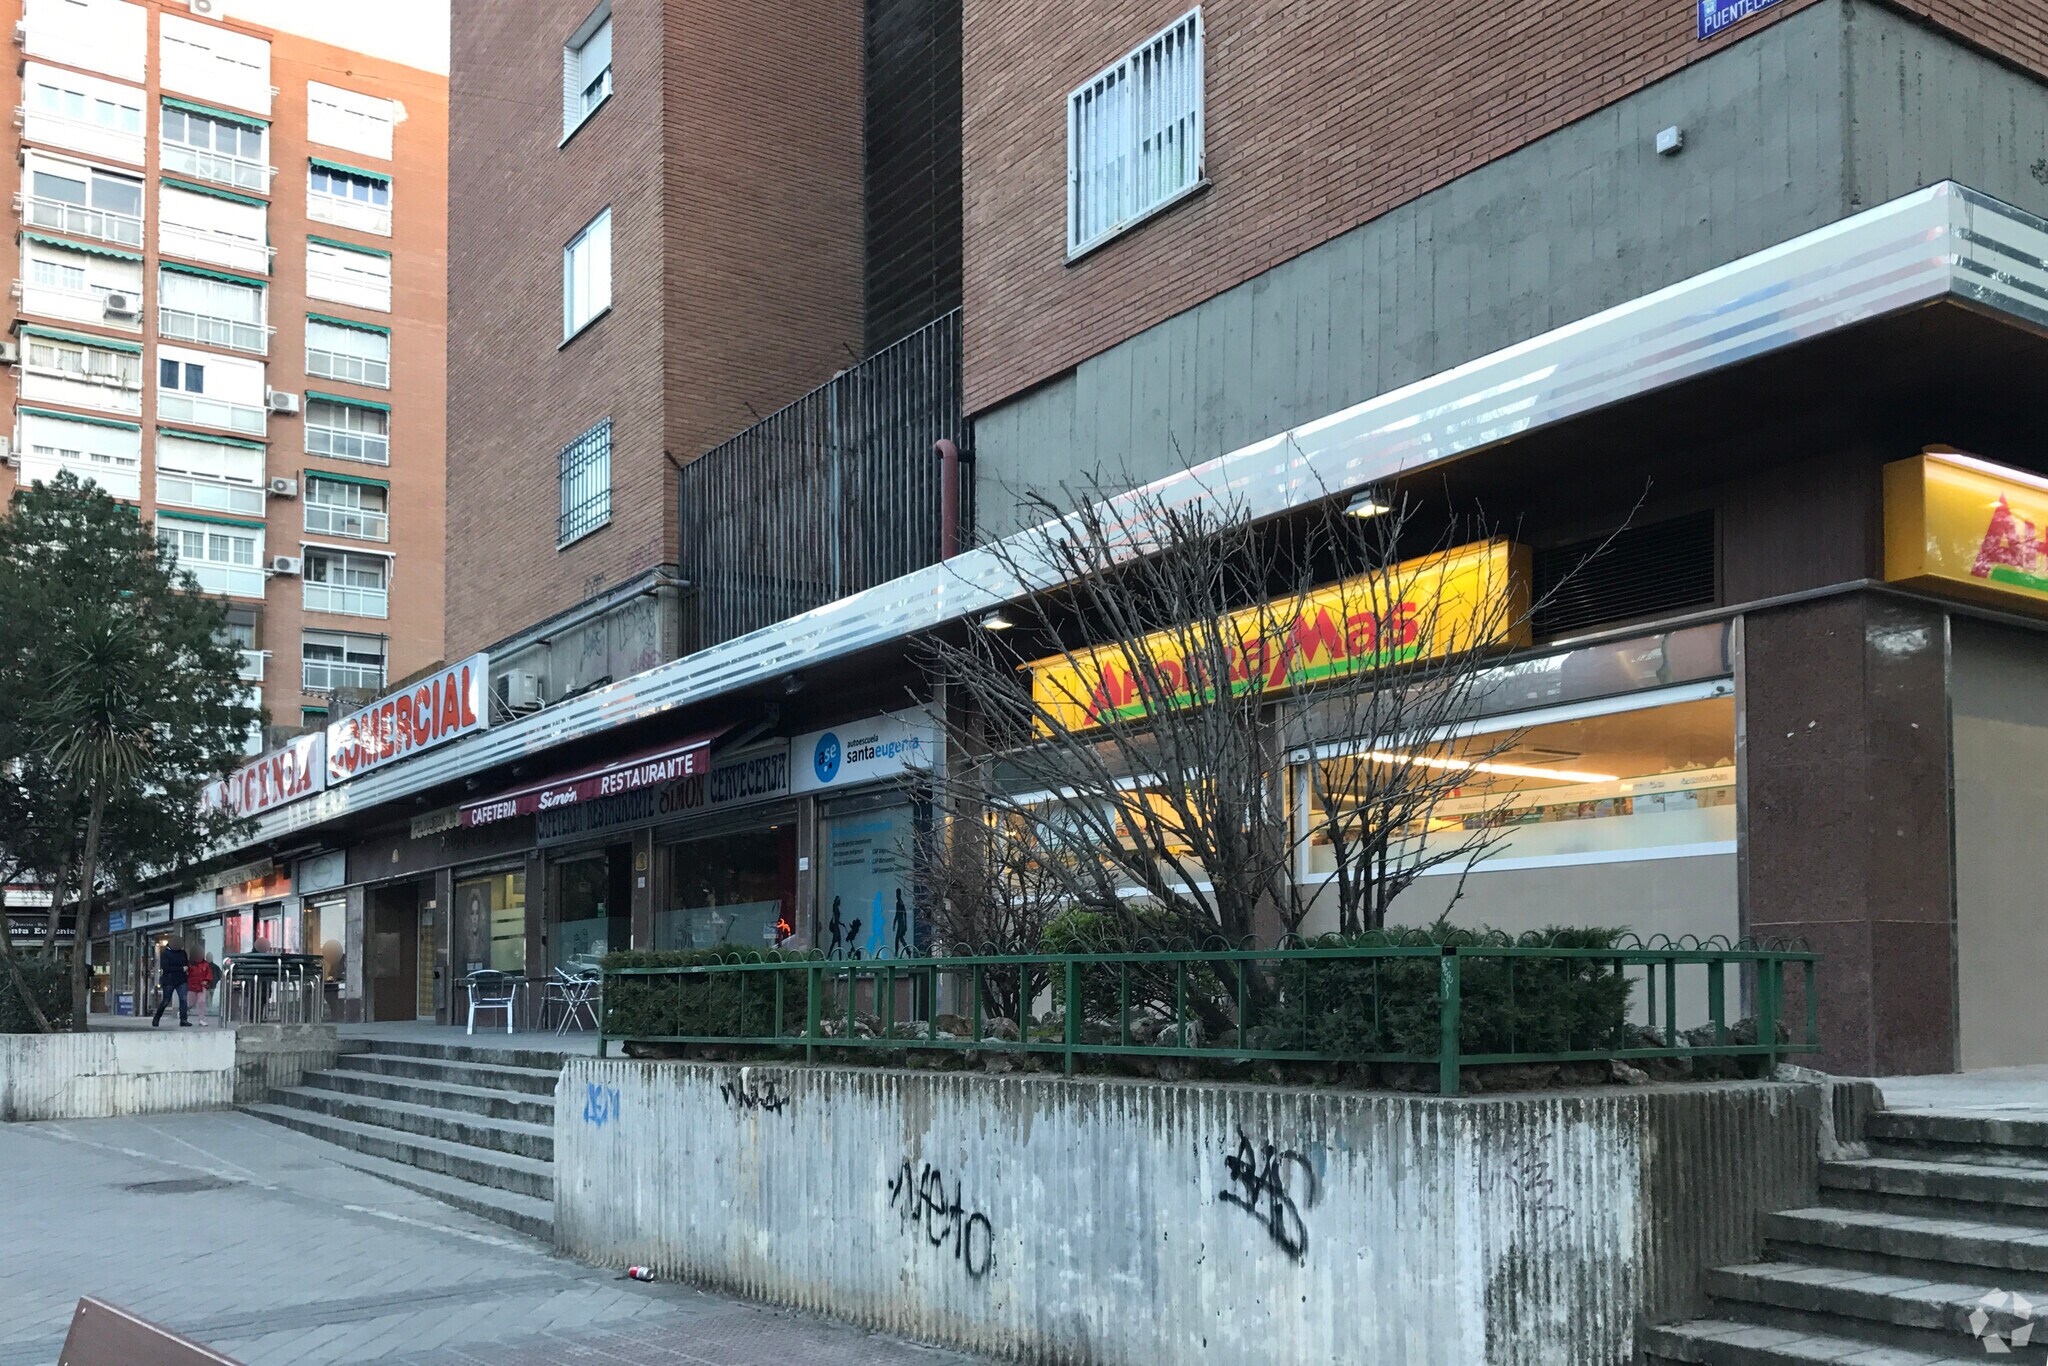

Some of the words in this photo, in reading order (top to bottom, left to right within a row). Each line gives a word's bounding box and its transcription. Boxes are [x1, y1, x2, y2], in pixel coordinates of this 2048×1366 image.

[330, 665, 476, 778] COMERCIAL
[818, 743, 837, 767] ase
[847, 734, 879, 749] autoescuela
[847, 736, 919, 763] santaeugena
[471, 799, 517, 826] CAFETERIA
[537, 787, 577, 810] Simón
[600, 753, 693, 795] RESTAURANTE
